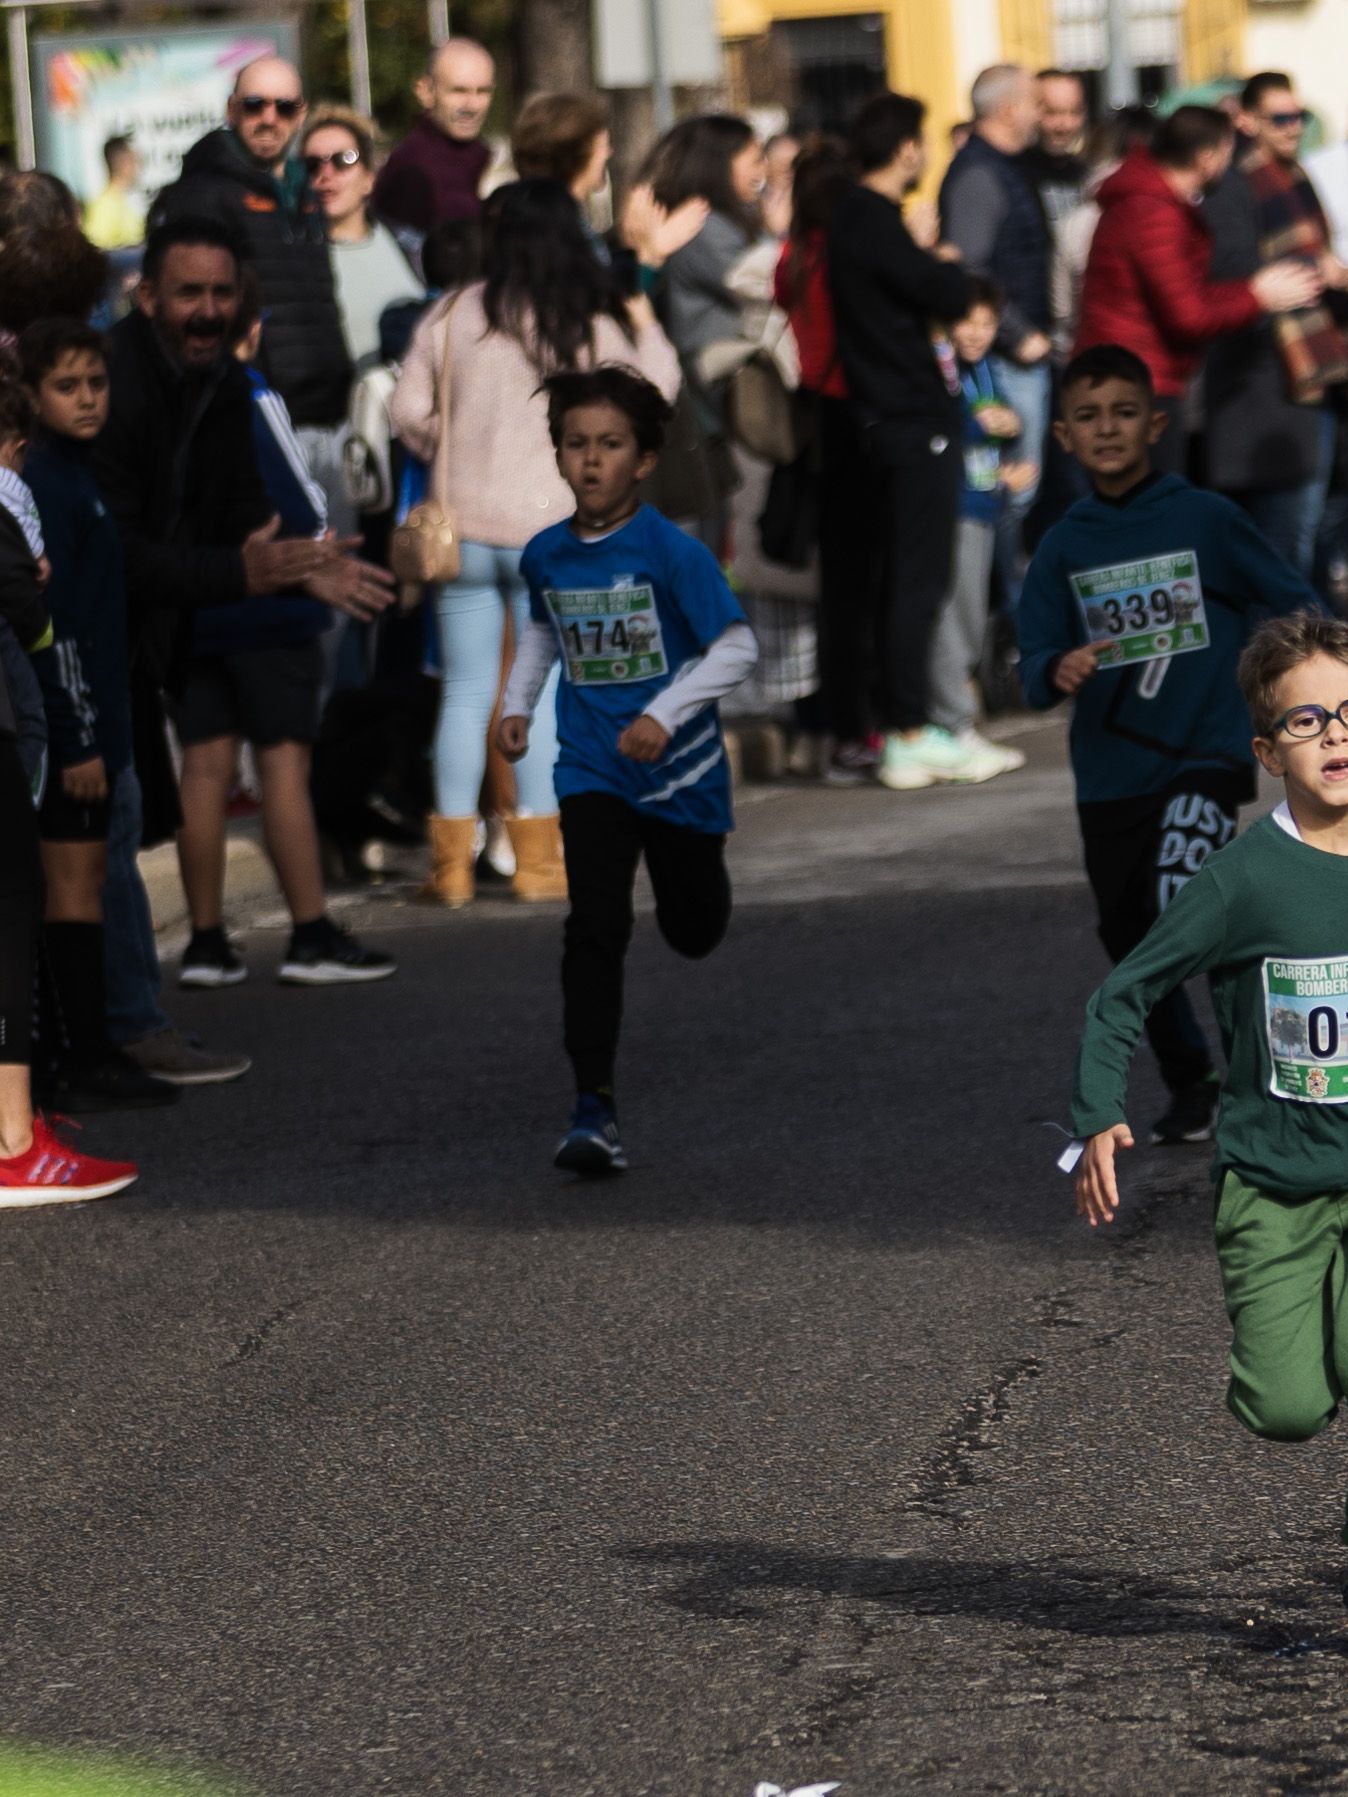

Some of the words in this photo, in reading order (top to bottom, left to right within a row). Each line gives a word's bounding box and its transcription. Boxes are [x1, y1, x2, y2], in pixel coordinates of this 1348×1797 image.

[1103, 588, 1175, 635] 339
[568, 619, 630, 655] 174
[1157, 830, 1213, 872] DO
[1273, 963, 1327, 979] CARRERA
